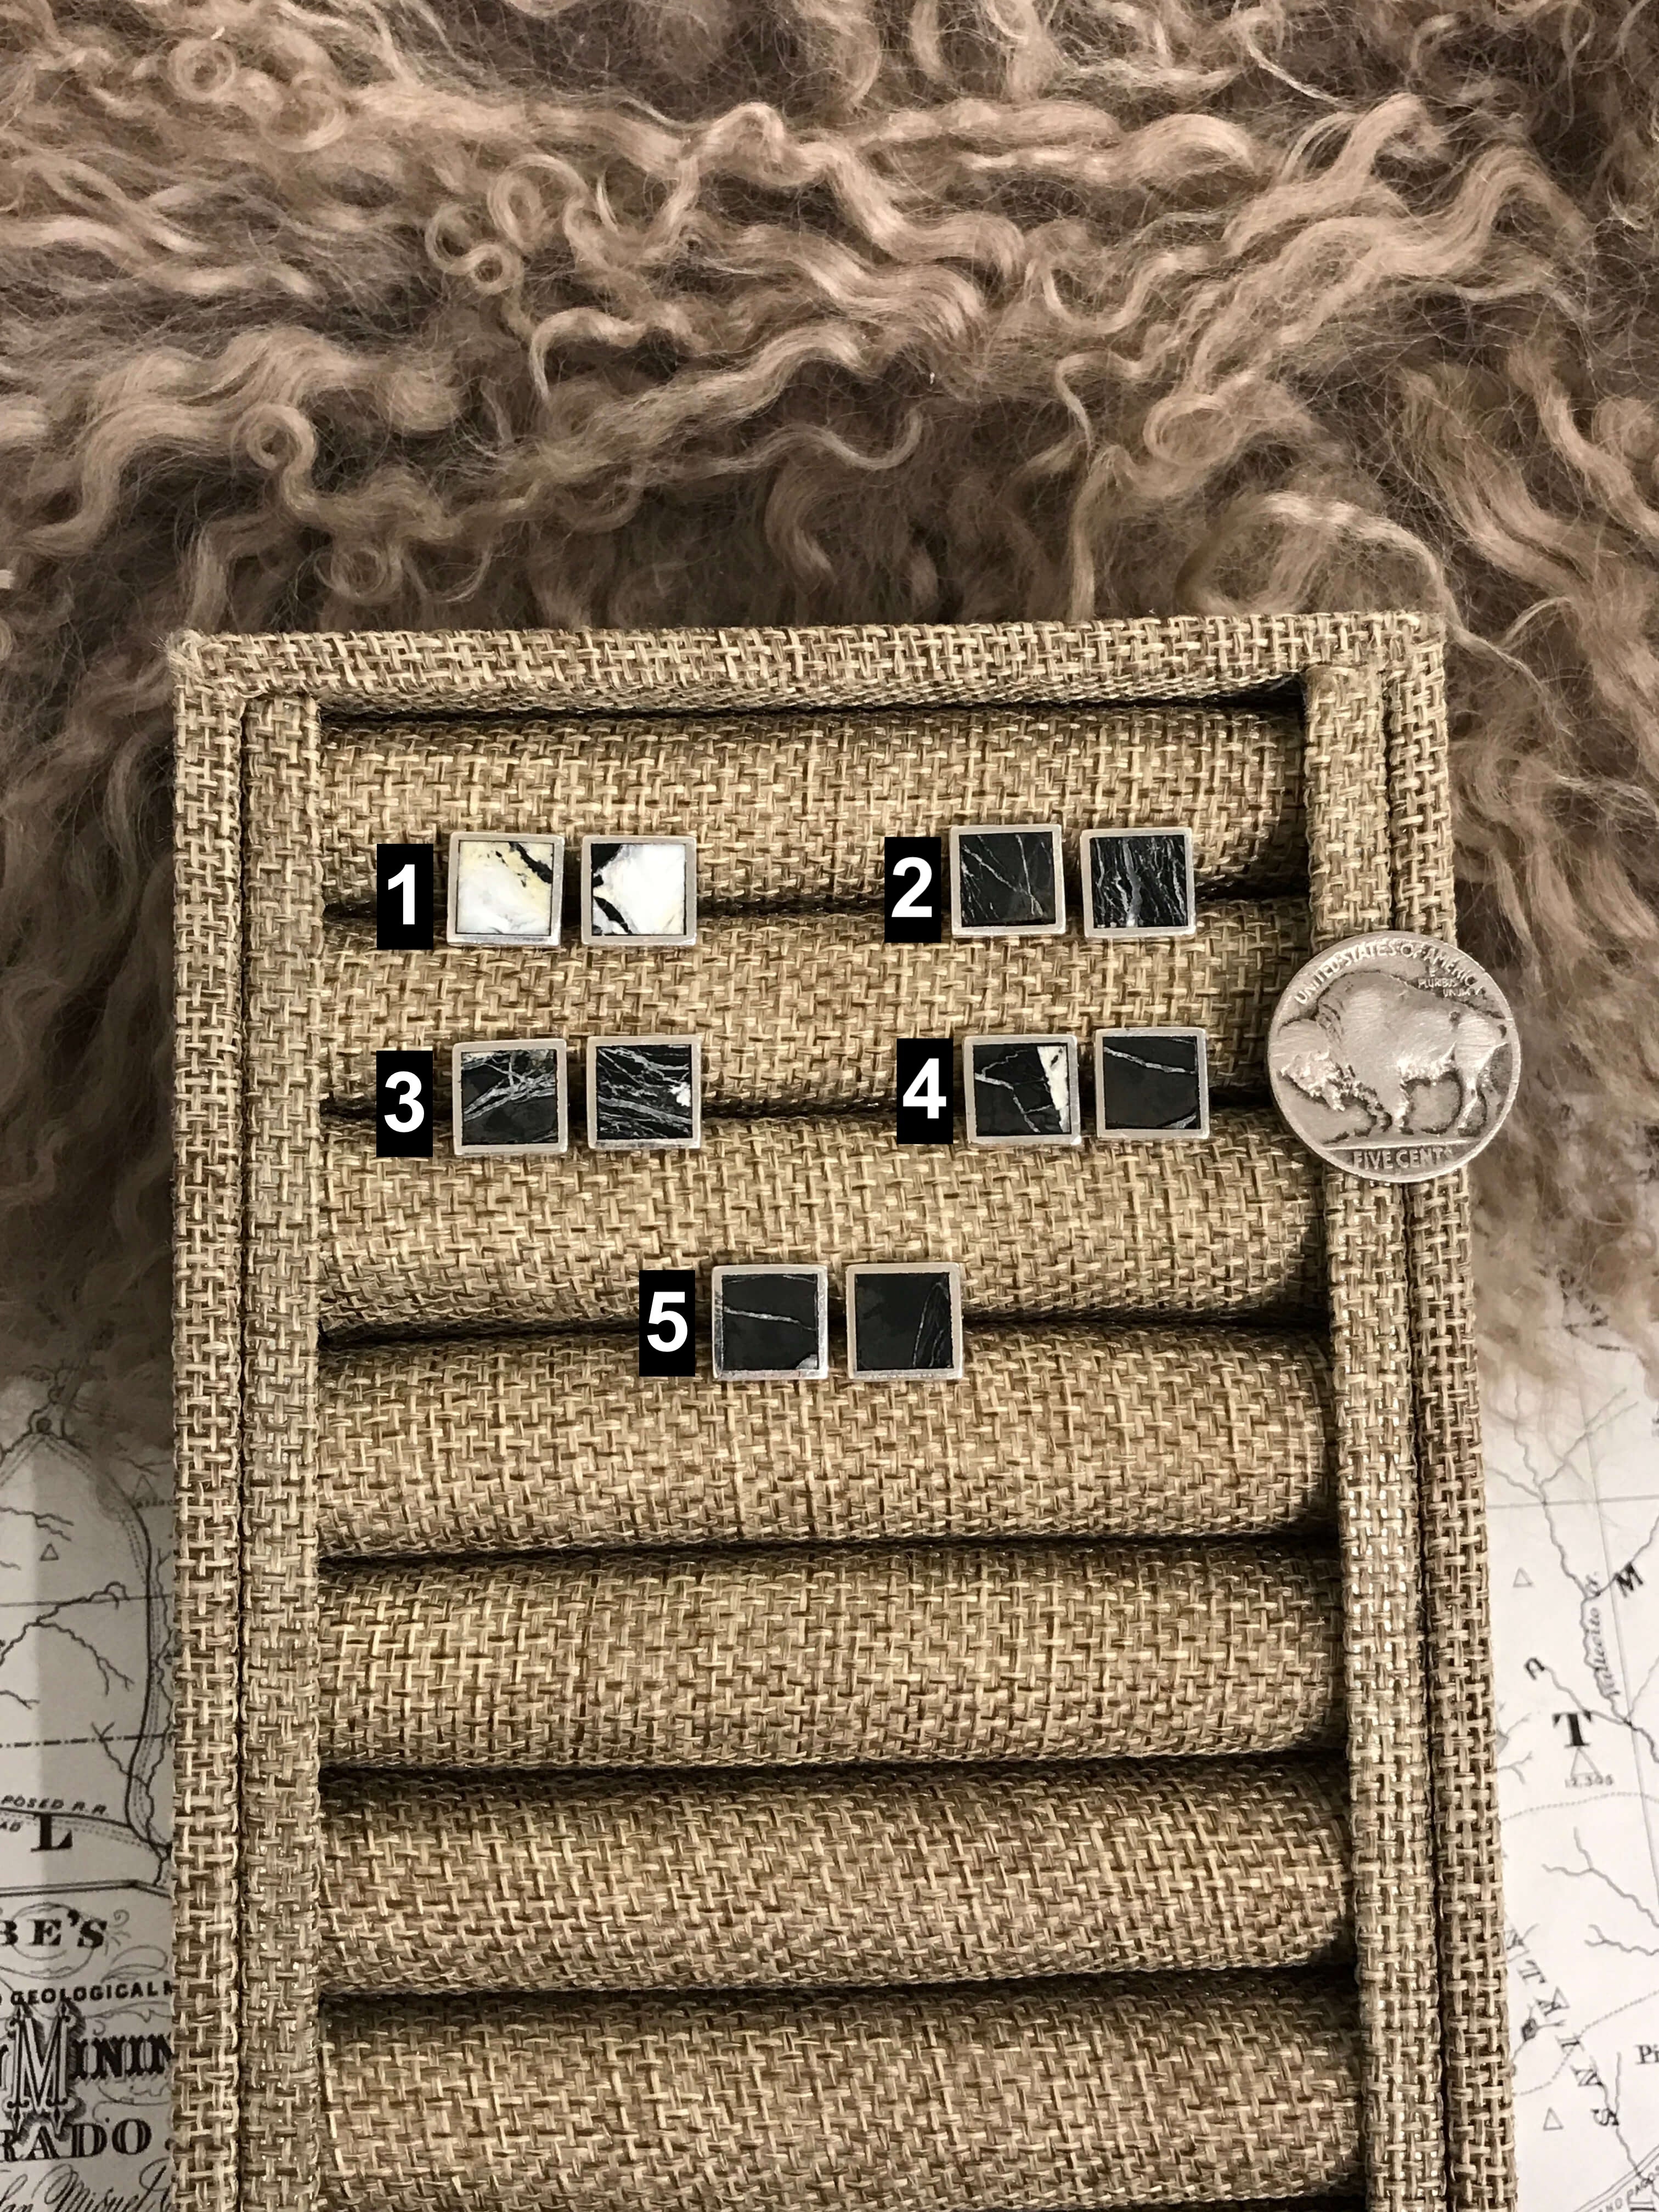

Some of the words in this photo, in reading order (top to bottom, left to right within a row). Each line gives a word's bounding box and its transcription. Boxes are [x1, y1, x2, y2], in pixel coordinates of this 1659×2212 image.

[1294, 953, 1341, 1005] UNITED
[1342, 938, 1397, 966] STATES
[1353, 1150, 1393, 1170] FIVE
[1552, 1709, 1592, 1748] T
[31, 1812, 72, 1852] L
[11, 1982, 158, 2005] GEOLOGICAL
